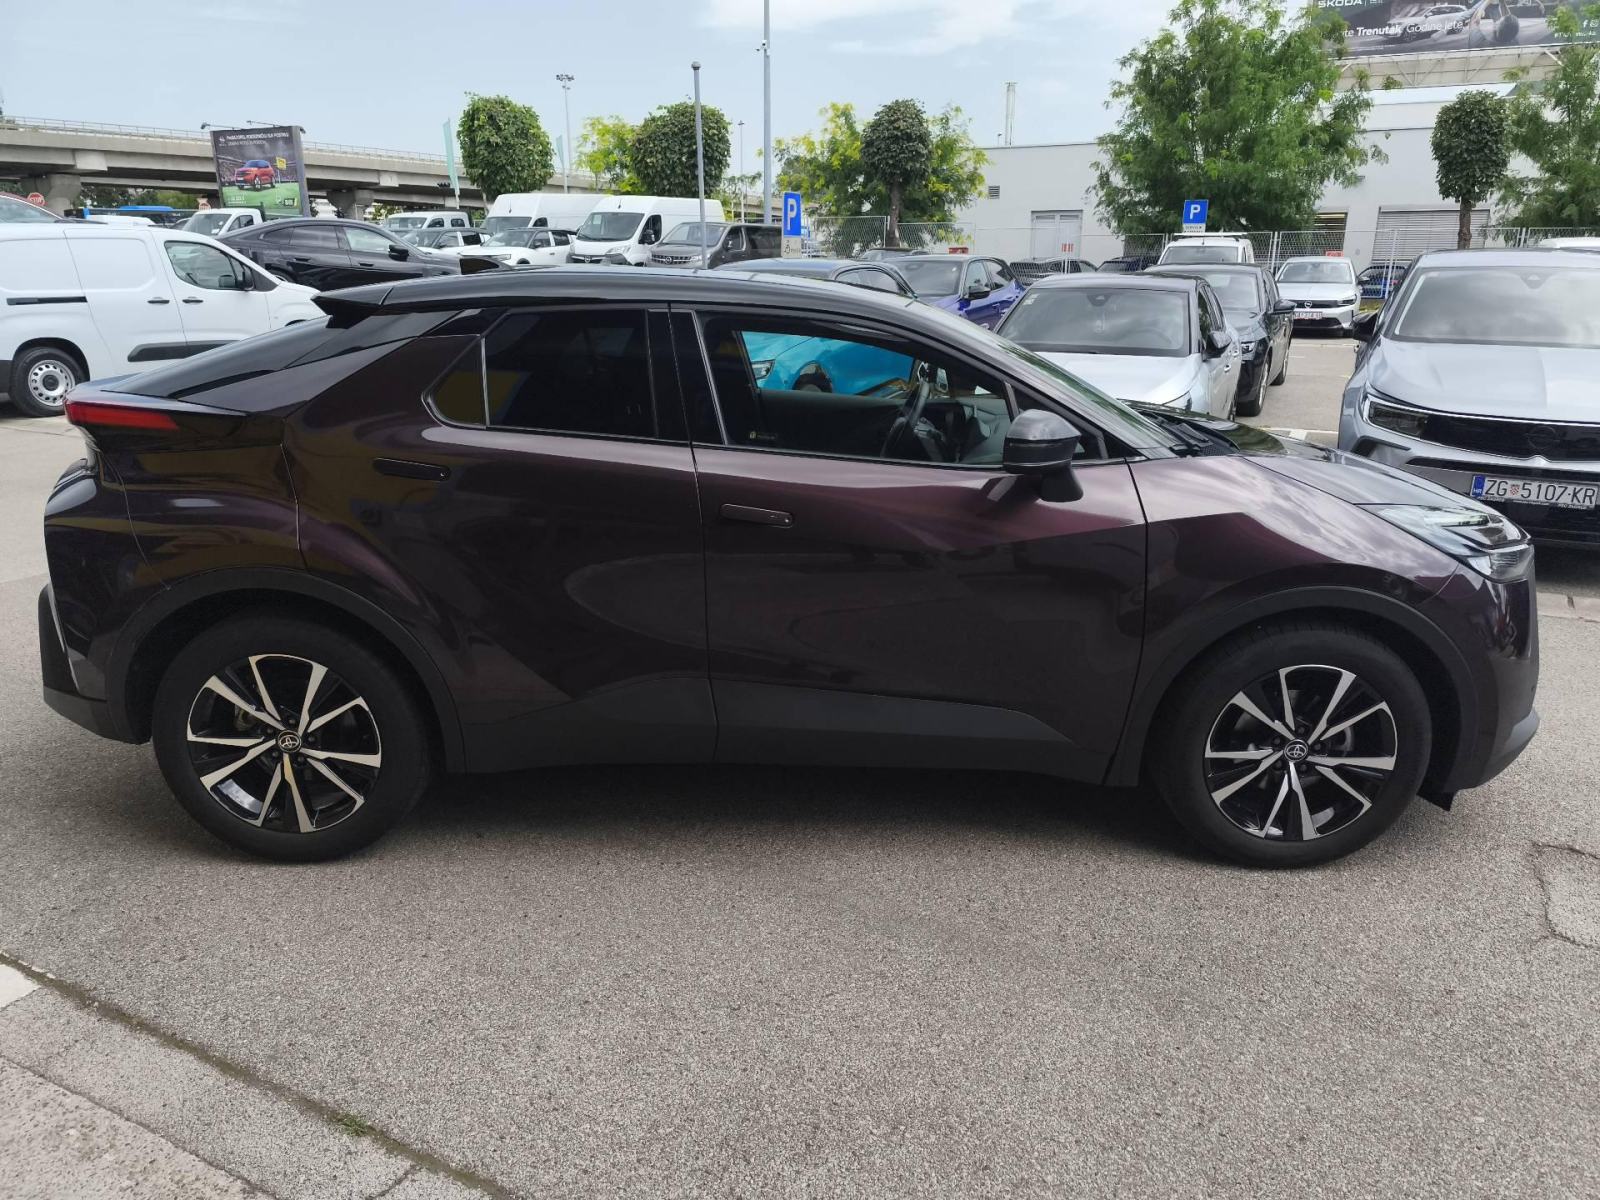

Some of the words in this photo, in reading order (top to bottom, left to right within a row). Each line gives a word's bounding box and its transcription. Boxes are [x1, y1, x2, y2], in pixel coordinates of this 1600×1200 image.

[787, 198, 797, 231] P
[1189, 204, 1201, 220] P
[1485, 479, 1509, 497] ZG
